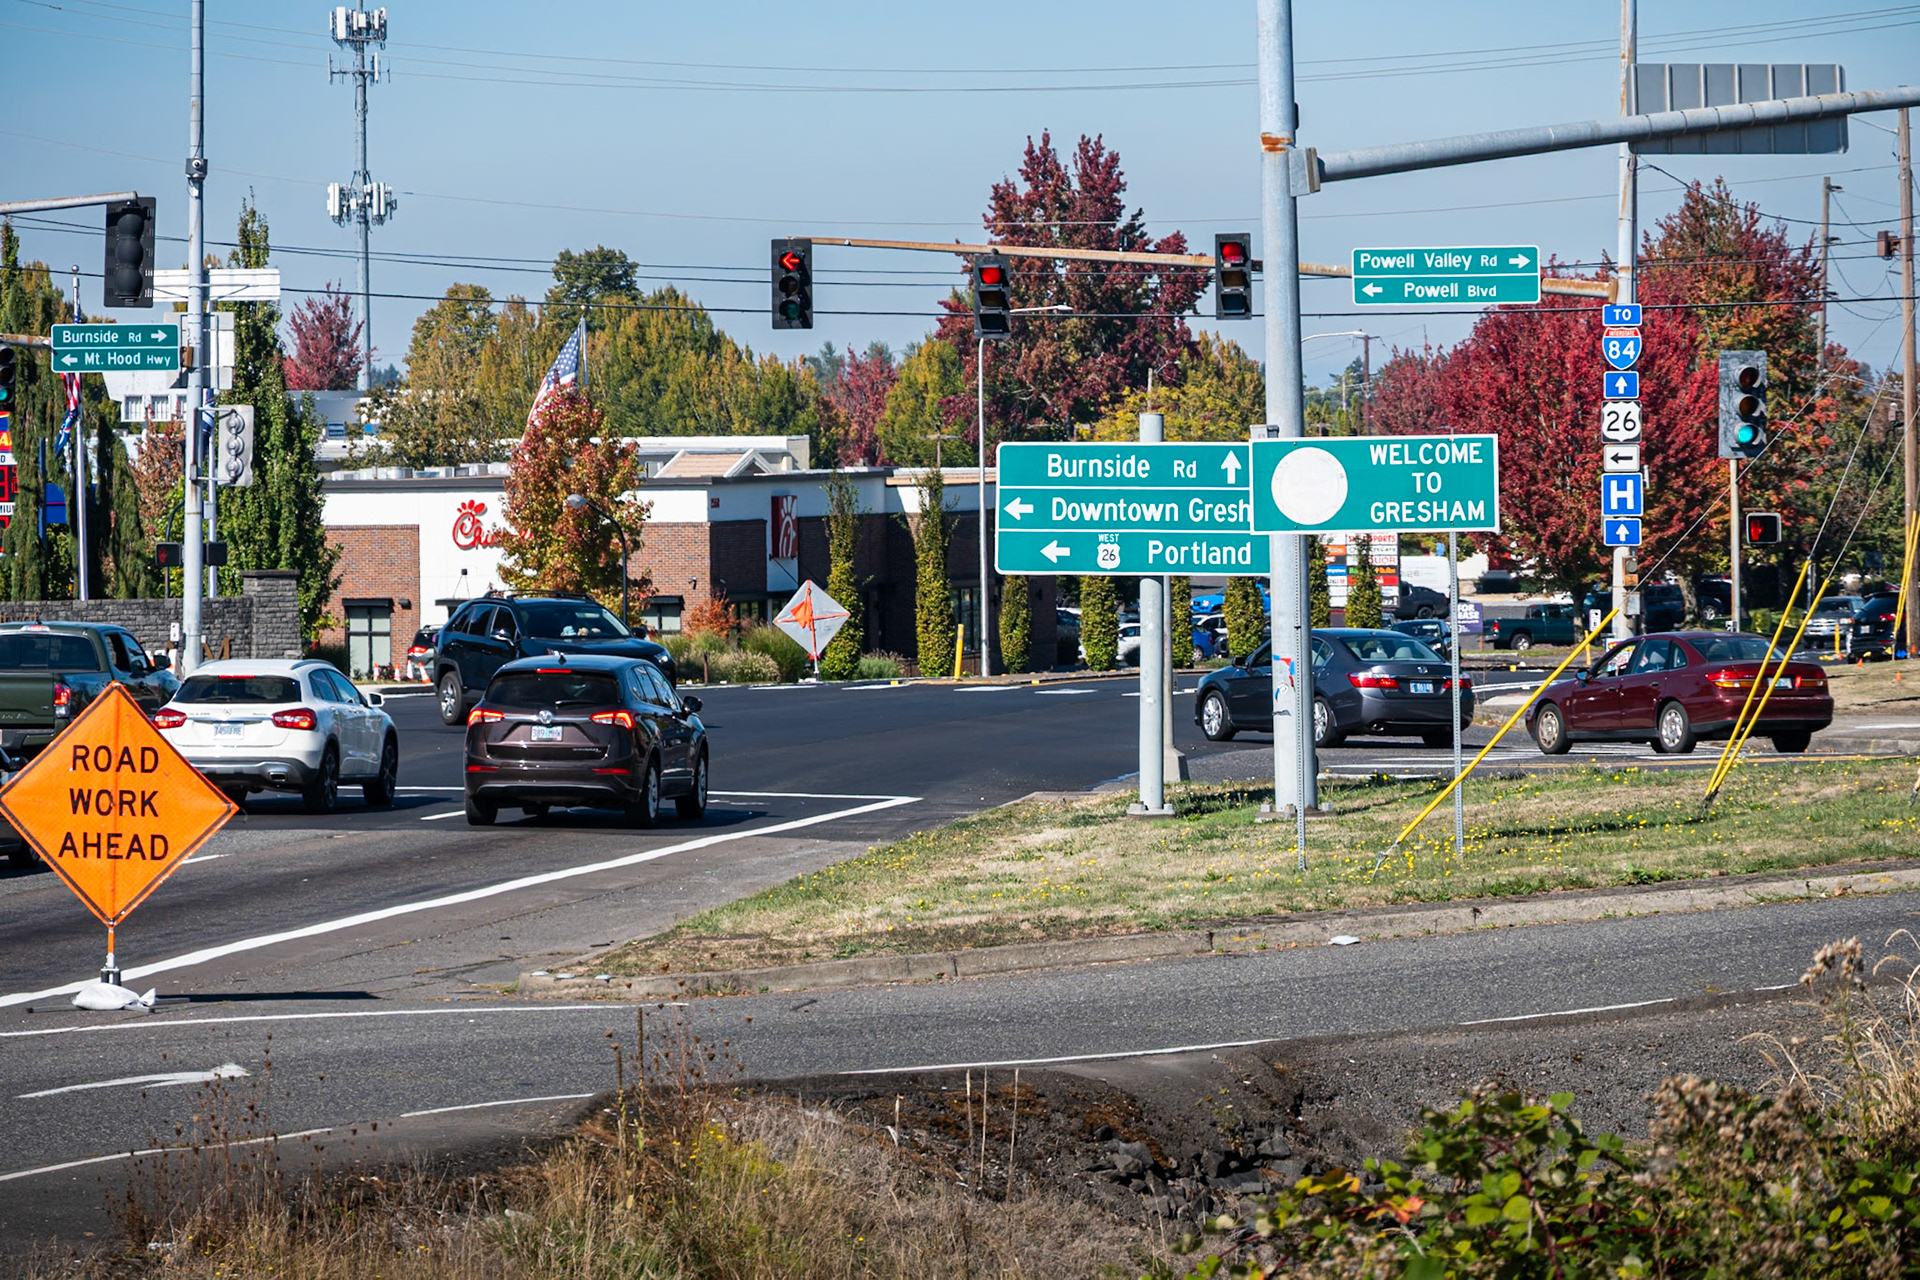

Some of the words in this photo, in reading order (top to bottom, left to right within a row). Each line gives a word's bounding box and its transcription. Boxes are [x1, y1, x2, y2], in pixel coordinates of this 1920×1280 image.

[1360, 253, 1415, 269] Powell
[1424, 252, 1472, 271] Valley
[1481, 255, 1498, 267] Rd
[1404, 282, 1459, 298] Powell
[1467, 285, 1497, 297] Blvd
[1613, 308, 1632, 321] TO
[62, 330, 119, 343] Burnside
[128, 332, 142, 343] Rd
[84, 352, 104, 365] Mt.
[107, 351, 141, 365] Hood
[146, 354, 171, 367] Hwy
[1608, 340, 1636, 360] 84
[1606, 410, 1637, 432] 26
[1369, 442, 1483, 465] WELCOME
[1047, 453, 1150, 478] Burnside
[1173, 459, 1197, 478] Rd
[1411, 471, 1442, 494] TO
[1610, 479, 1635, 510] H
[1051, 497, 1179, 522] Downtown
[1369, 500, 1485, 524] GRESHAM
[1098, 533, 1119, 543] WEST
[1101, 548, 1117, 562] 26
[1148, 540, 1251, 565] Portland
[1457, 610, 1480, 620] EASE
[72, 744, 159, 774] ROAD
[69, 787, 159, 817] WORK
[57, 831, 169, 861] AHEAD
